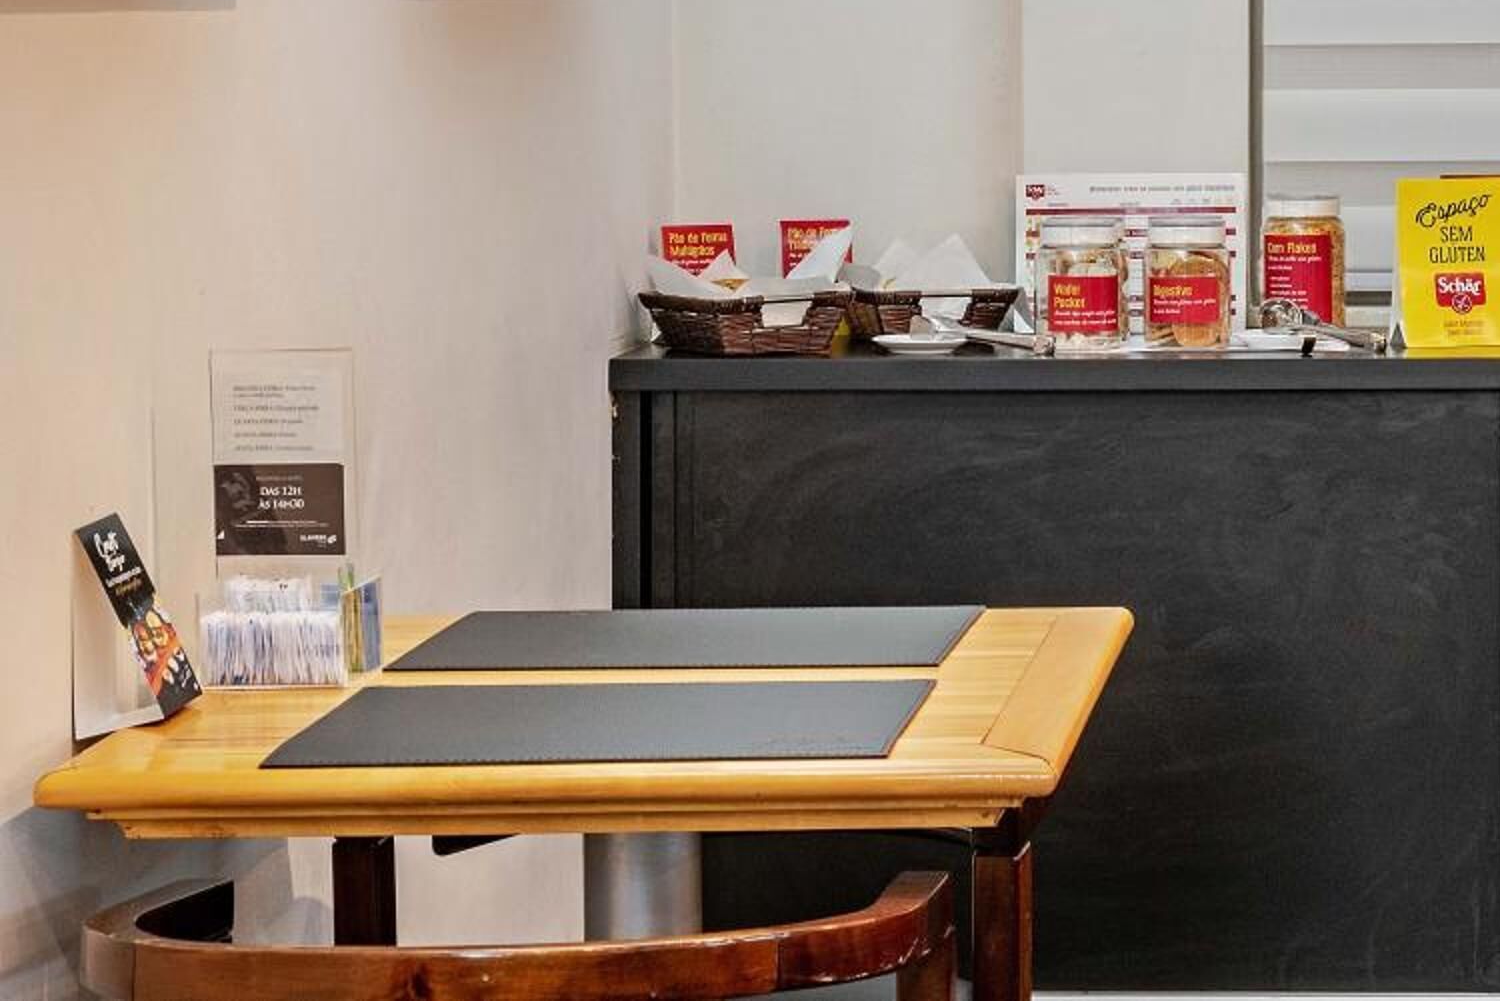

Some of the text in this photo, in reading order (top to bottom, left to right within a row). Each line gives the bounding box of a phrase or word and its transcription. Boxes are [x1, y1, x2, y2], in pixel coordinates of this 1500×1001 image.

[1416, 194, 1493, 228] Espaço
[1439, 226, 1473, 243] SEM
[1437, 276, 1482, 296] Schär
[259, 486, 280, 496] DAS
